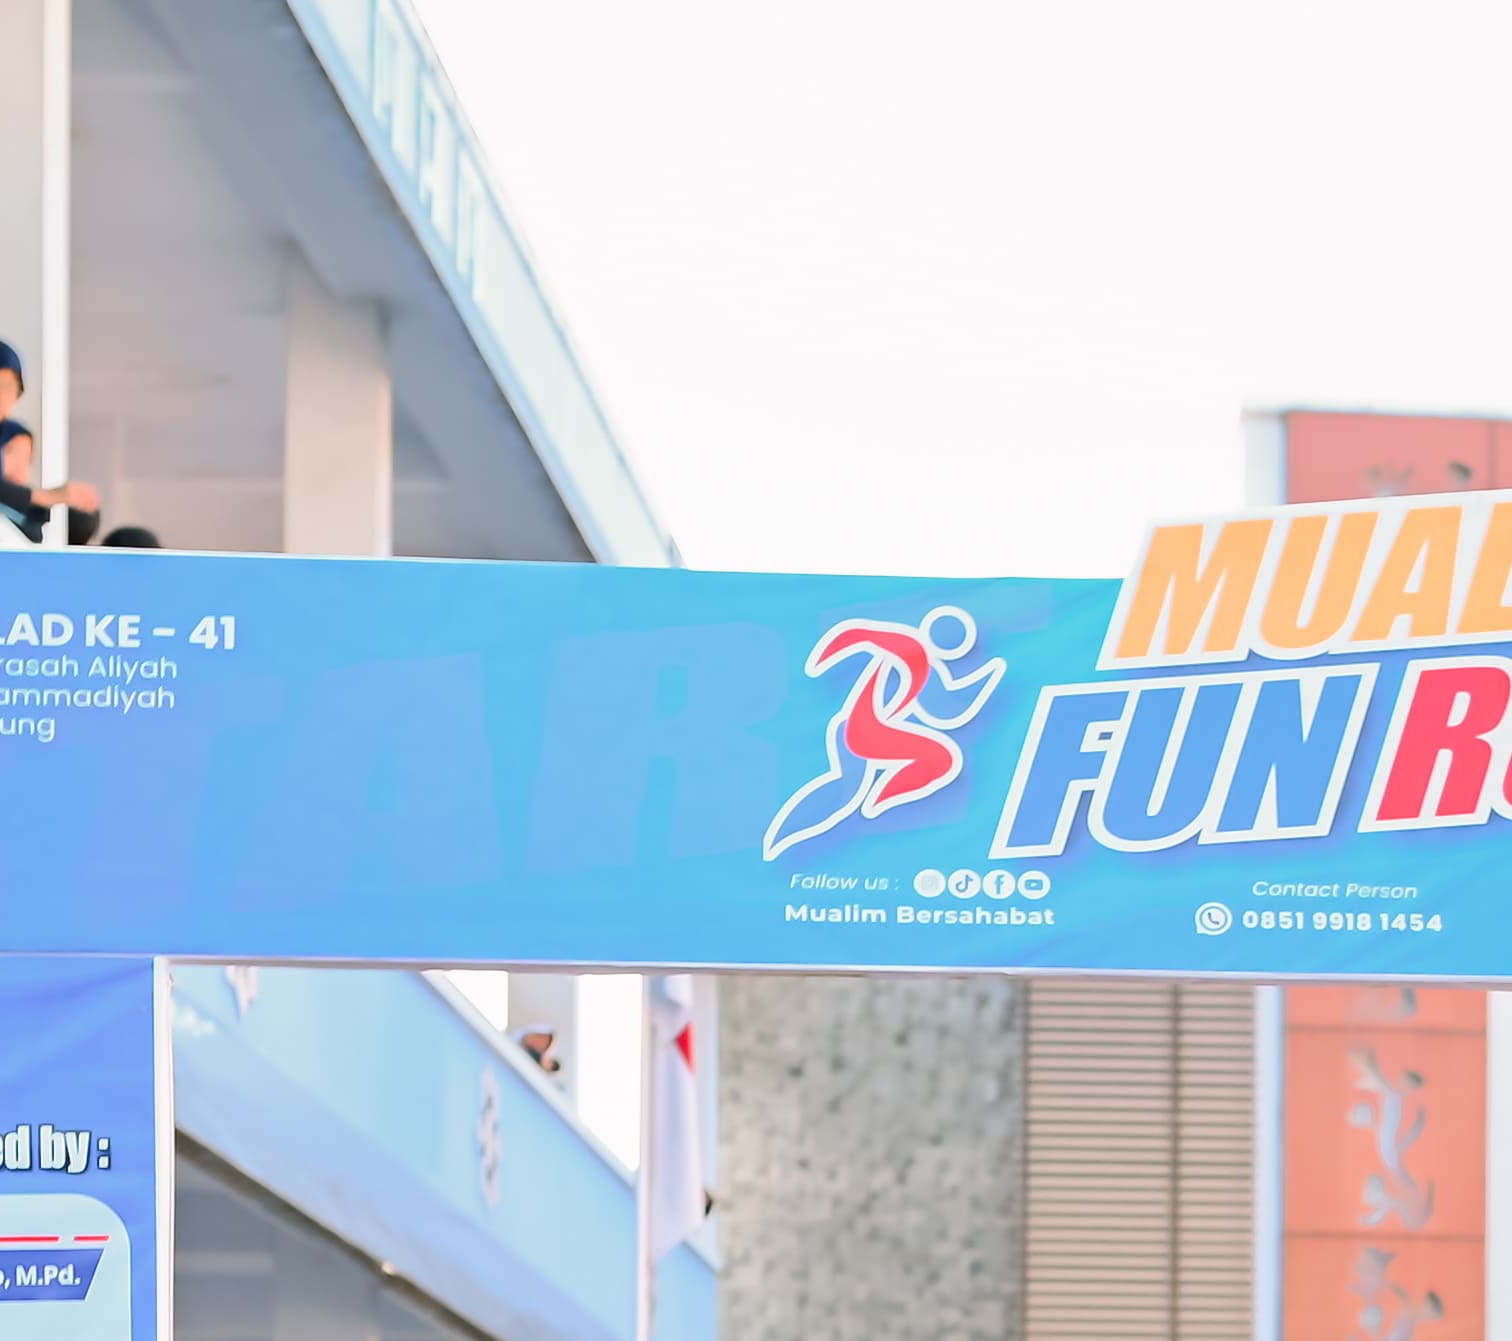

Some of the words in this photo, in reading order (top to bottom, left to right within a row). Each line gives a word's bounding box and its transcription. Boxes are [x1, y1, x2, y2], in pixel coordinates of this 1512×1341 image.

[86, 616, 141, 648] KE
[189, 617, 236, 650] 41
[88, 656, 178, 685] Aliyah
[1006, 674, 1360, 847] FUN
[790, 873, 859, 893] Follow
[866, 880, 889, 892] us
[1252, 880, 1329, 898] Contact
[1341, 881, 1418, 900] Person
[784, 903, 889, 927] Mualim
[896, 905, 1055, 928] Bersahabat
[1242, 909, 1307, 933] 0851
[1312, 911, 1372, 934] 9918
[1377, 912, 1443, 935] 1454
[38, 1124, 91, 1175] by
[16, 1264, 81, 1288] M.Pd.
